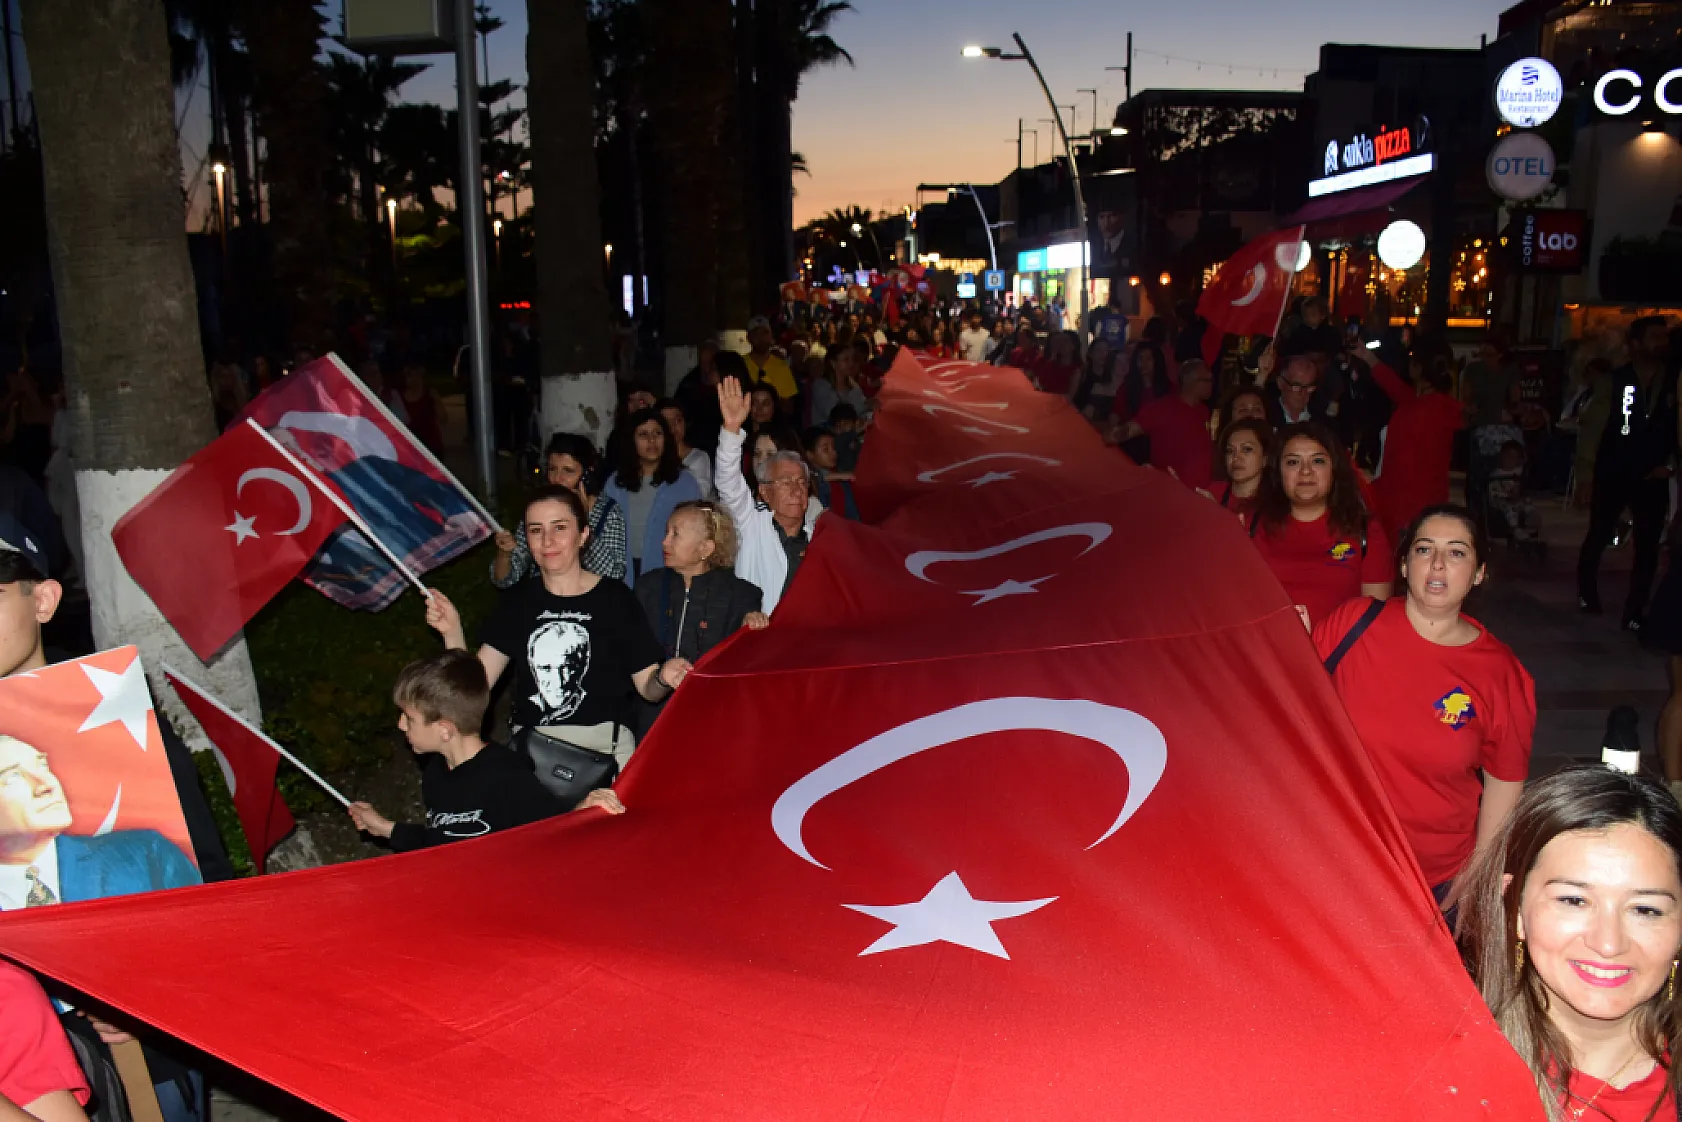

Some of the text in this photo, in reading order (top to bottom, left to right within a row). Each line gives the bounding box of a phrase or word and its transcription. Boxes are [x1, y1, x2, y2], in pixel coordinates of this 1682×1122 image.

[1499, 87, 1560, 102] Marina Hotel
[1374, 123, 1411, 167] pizza
[1495, 157, 1552, 176] OTEL
[1522, 213, 1535, 266] coffee
